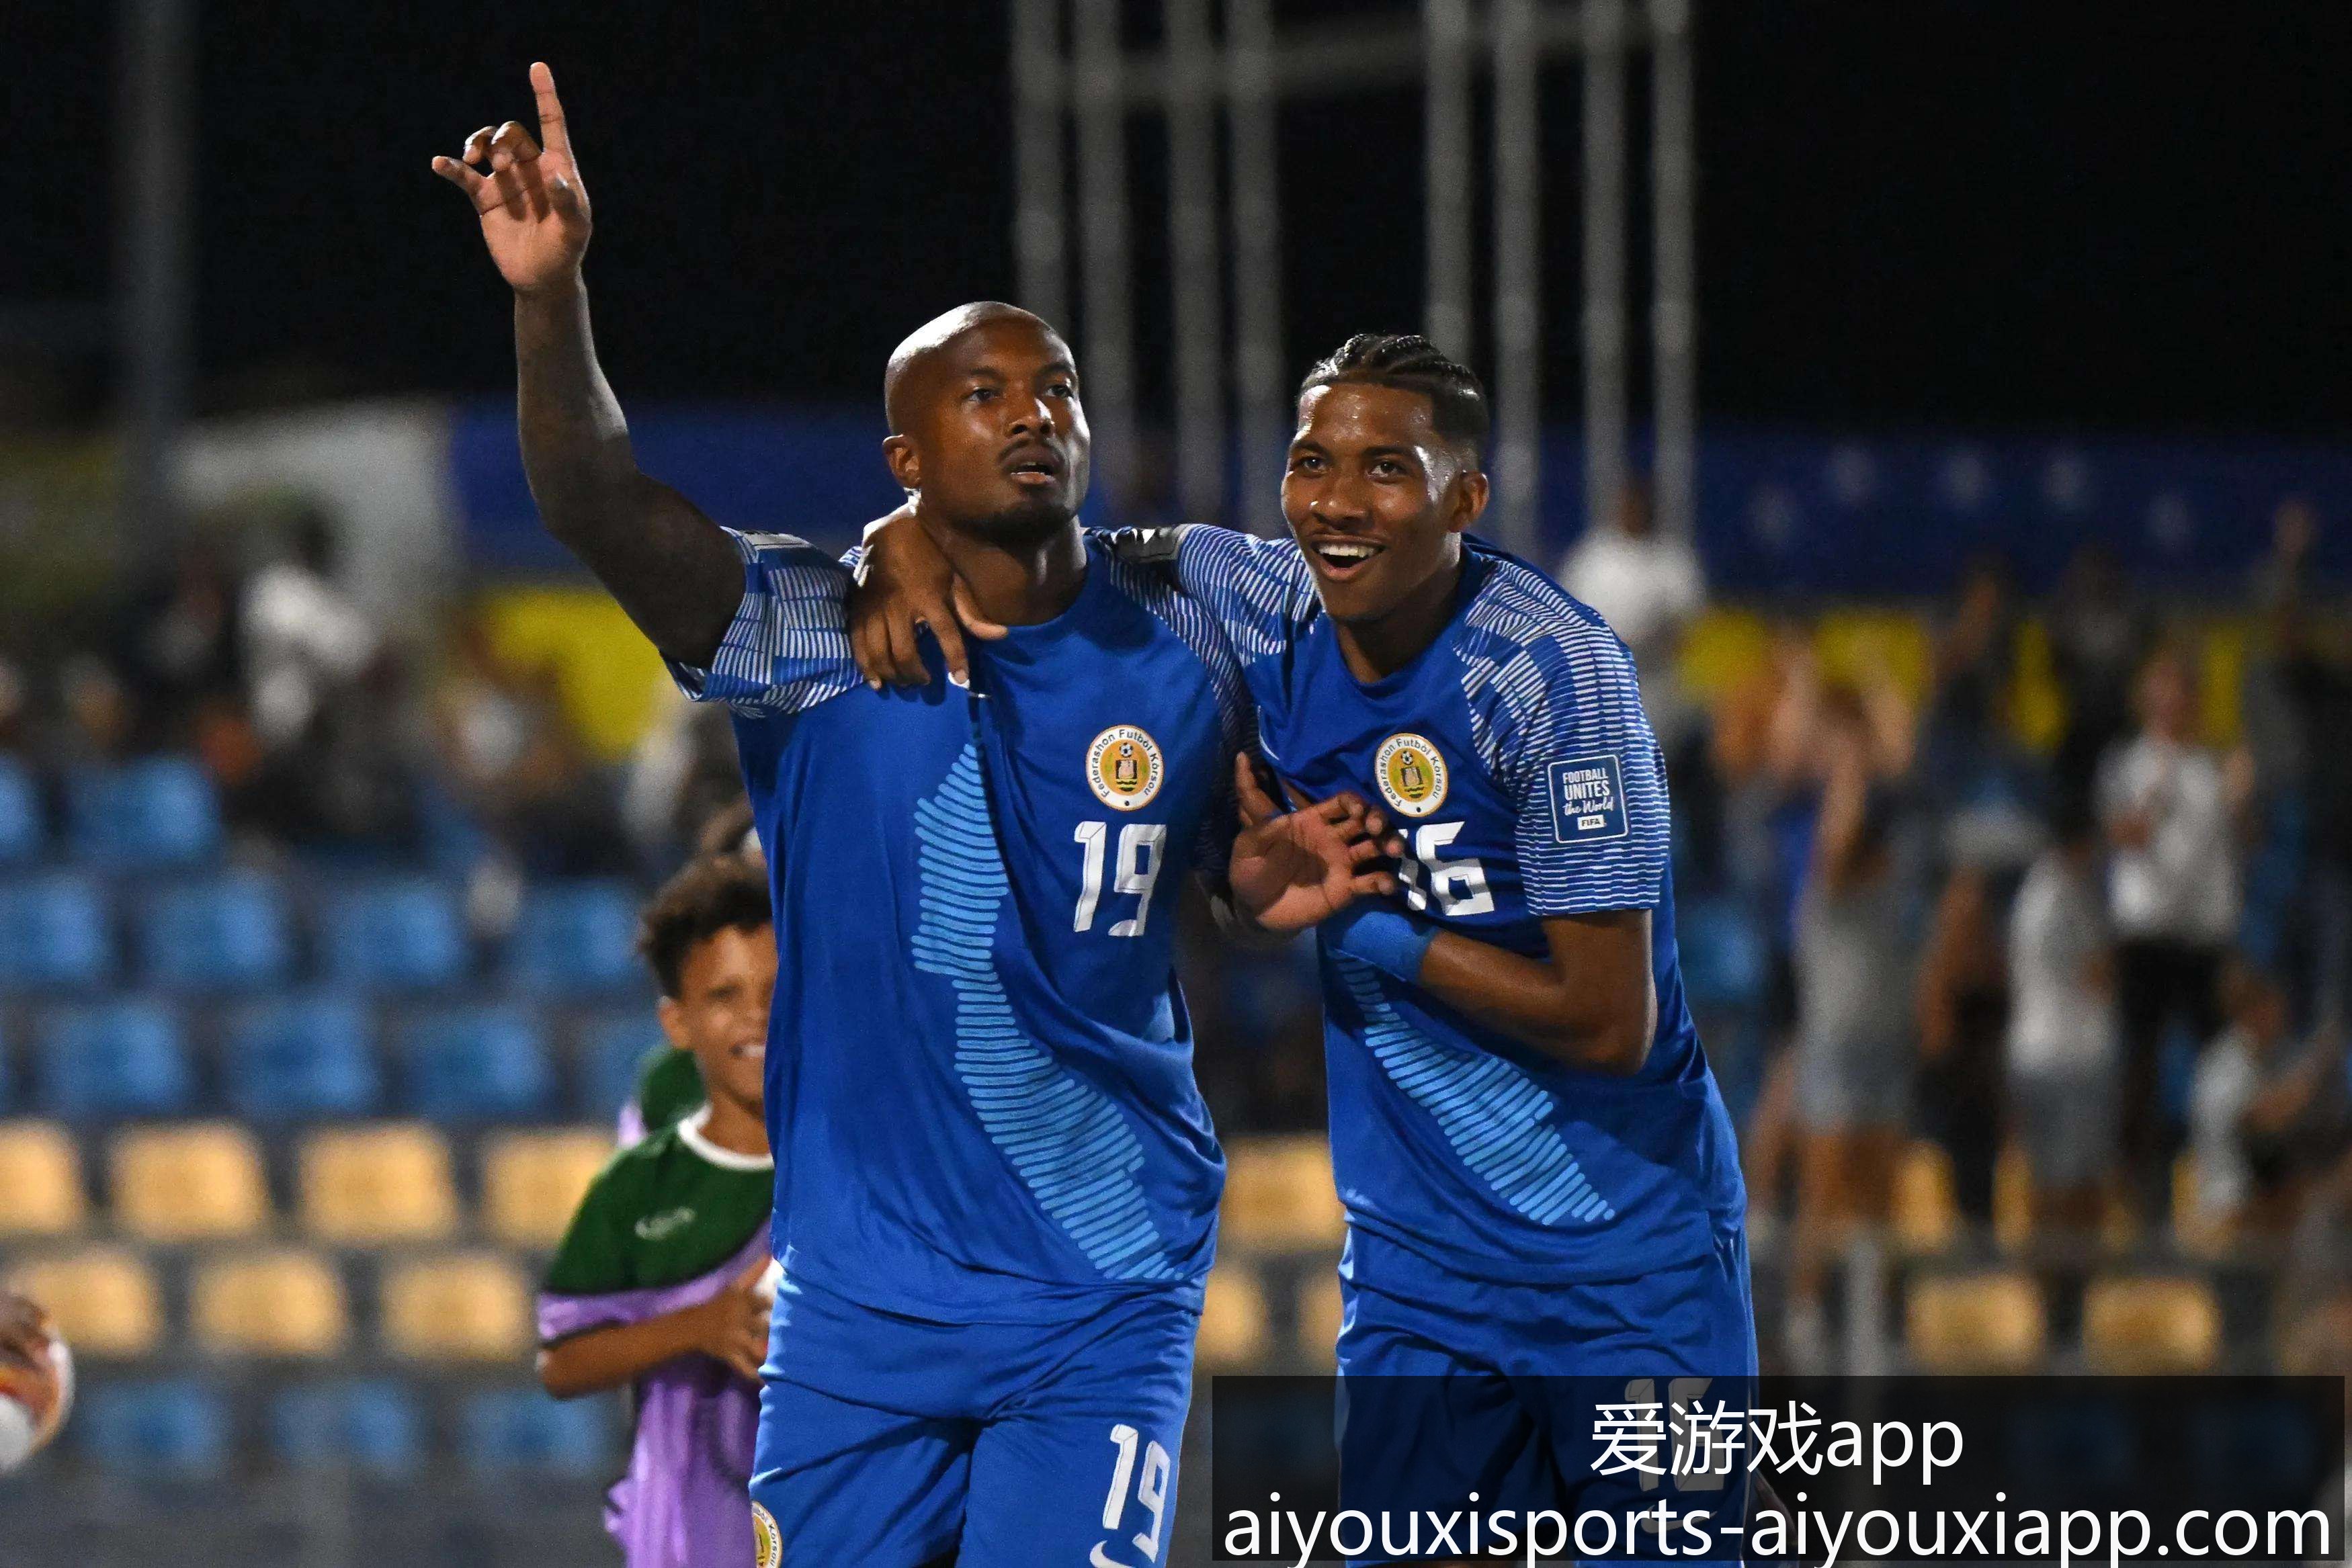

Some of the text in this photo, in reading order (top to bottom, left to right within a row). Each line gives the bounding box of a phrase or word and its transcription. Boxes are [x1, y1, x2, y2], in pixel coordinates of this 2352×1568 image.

[1092, 734, 1116, 797] Federashon
[1379, 744, 1402, 807] Federashon
[1562, 767, 1609, 784] FOOTBALL
[1562, 797, 1614, 816] the World
[1564, 780, 1611, 801] UNITES
[1581, 818, 1601, 828] FIFA
[1073, 821, 1167, 937] 19
[1102, 1424, 1171, 1563] 19
